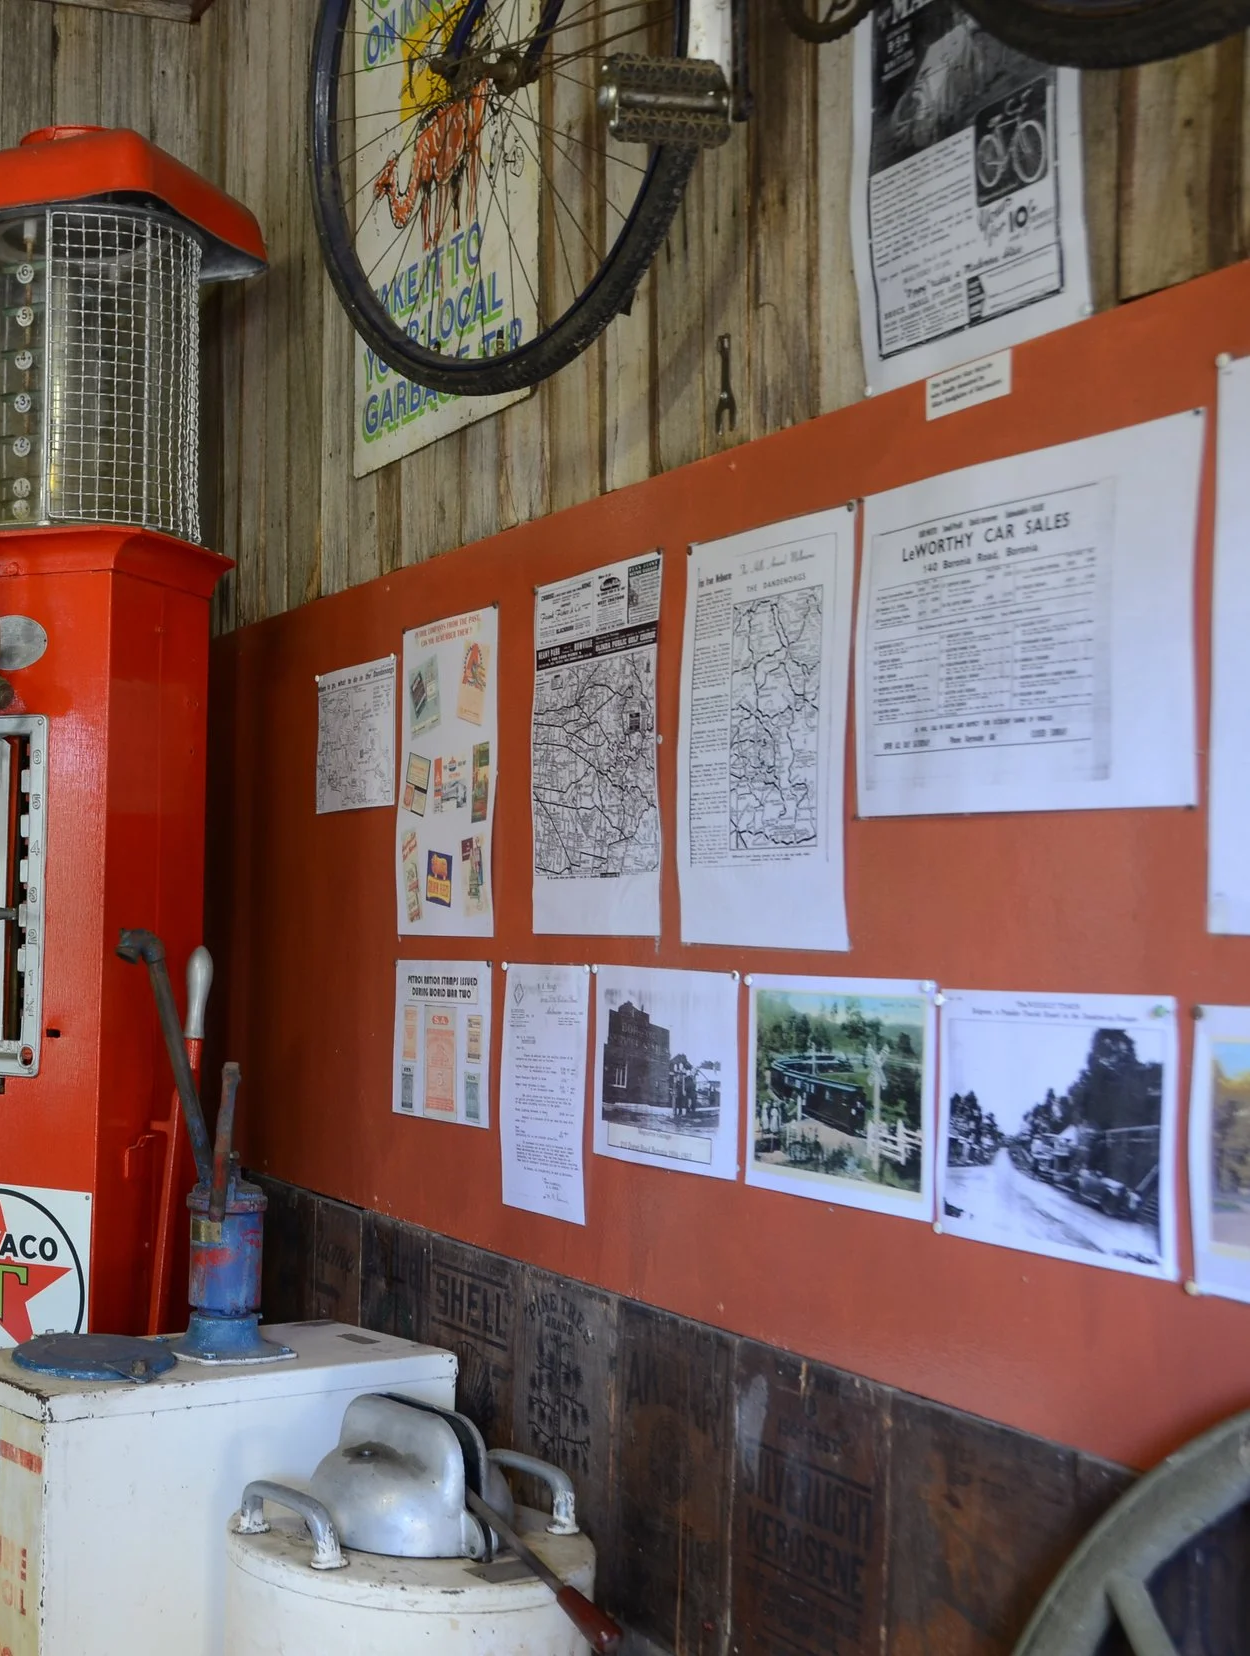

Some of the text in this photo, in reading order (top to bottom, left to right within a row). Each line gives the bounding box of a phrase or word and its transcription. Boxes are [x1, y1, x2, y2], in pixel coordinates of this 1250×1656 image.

[375, 262, 418, 313] AKE
[451, 221, 481, 275] TO
[428, 272, 502, 348] LOCAL
[902, 531, 973, 563] LeWORTHY
[984, 523, 1015, 543] CAR
[1025, 511, 1070, 536] SALES
[459, 990, 471, 998] TWO
[436, 1271, 507, 1339] SHELL
[746, 1505, 865, 1603] KEROSENE
